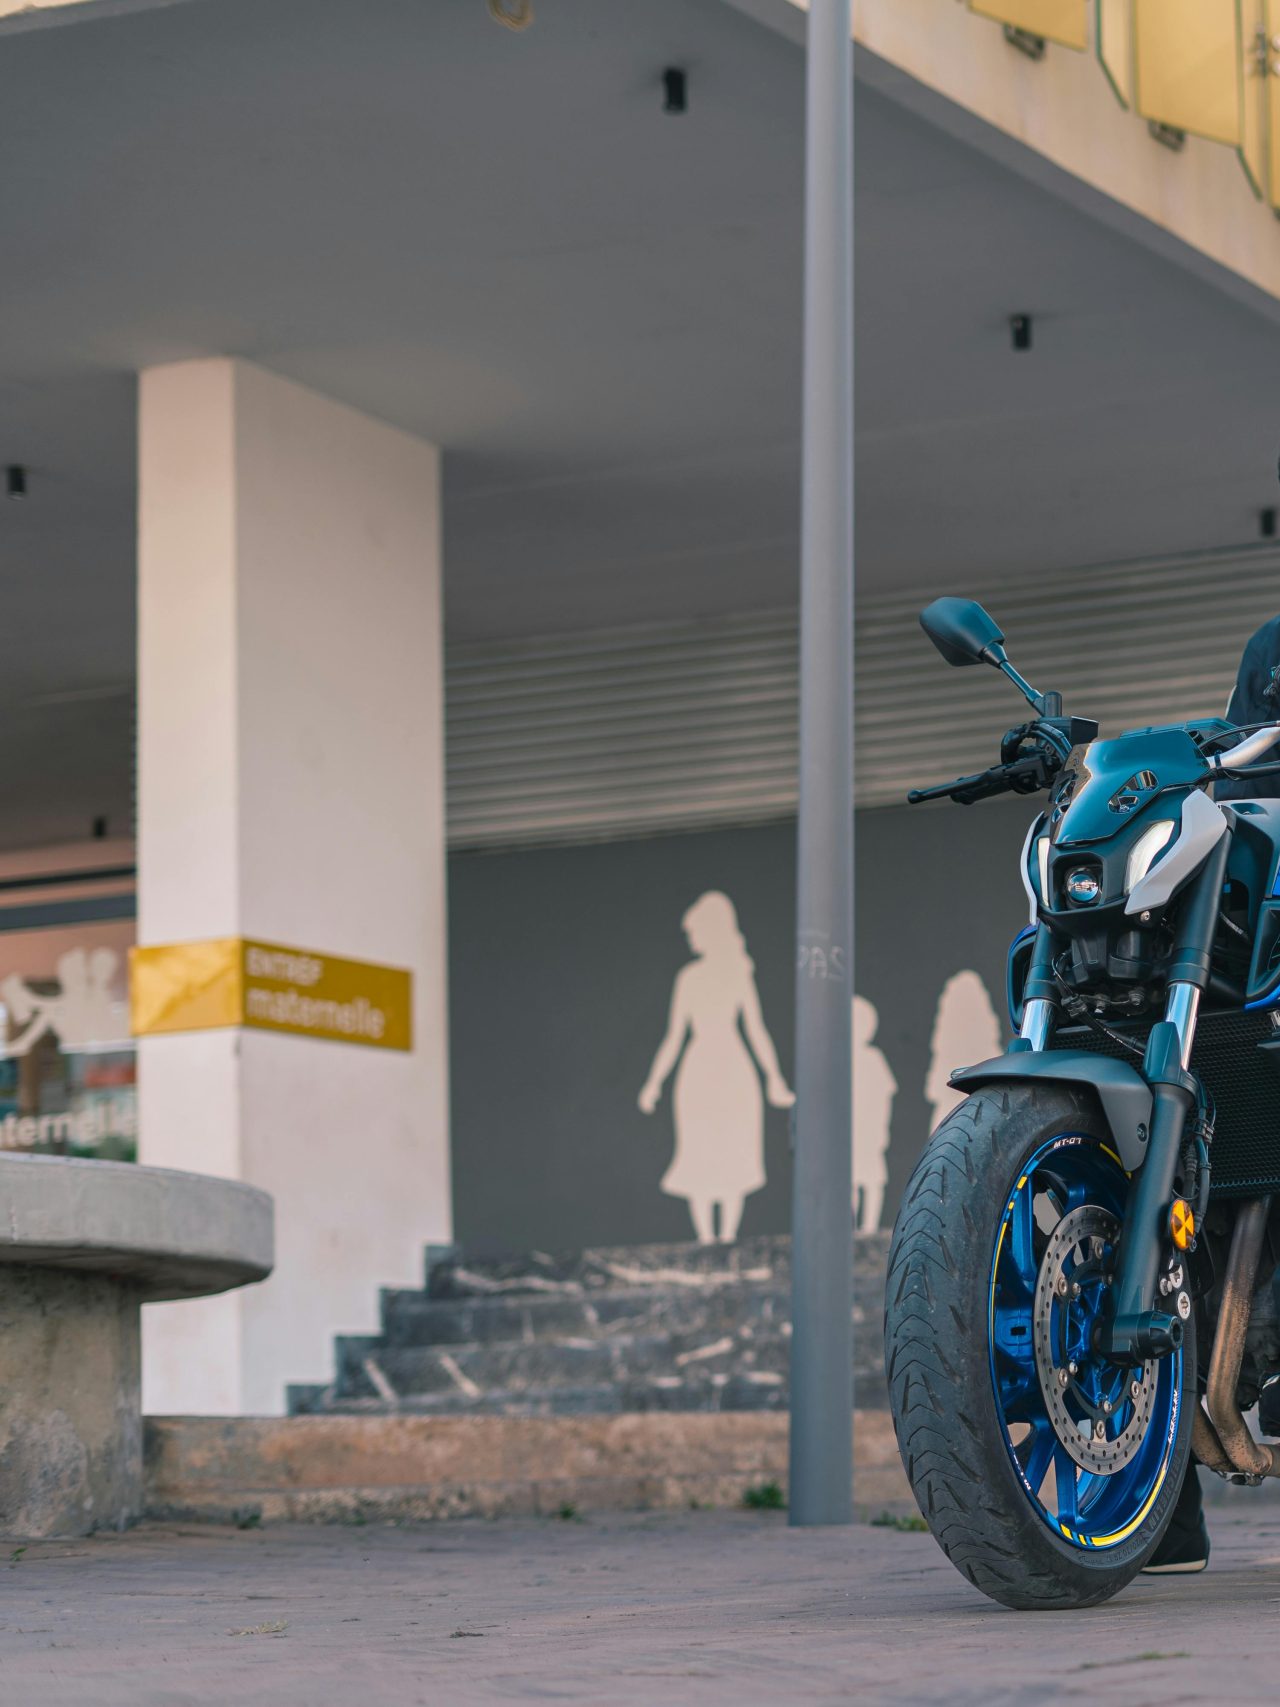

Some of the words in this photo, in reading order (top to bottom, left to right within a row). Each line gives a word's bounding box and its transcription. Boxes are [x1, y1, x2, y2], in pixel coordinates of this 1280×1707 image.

[246, 987, 385, 1040] maternelle
[0, 1098, 137, 1150] ternelle
[1053, 1137, 1082, 1149] MT-07
